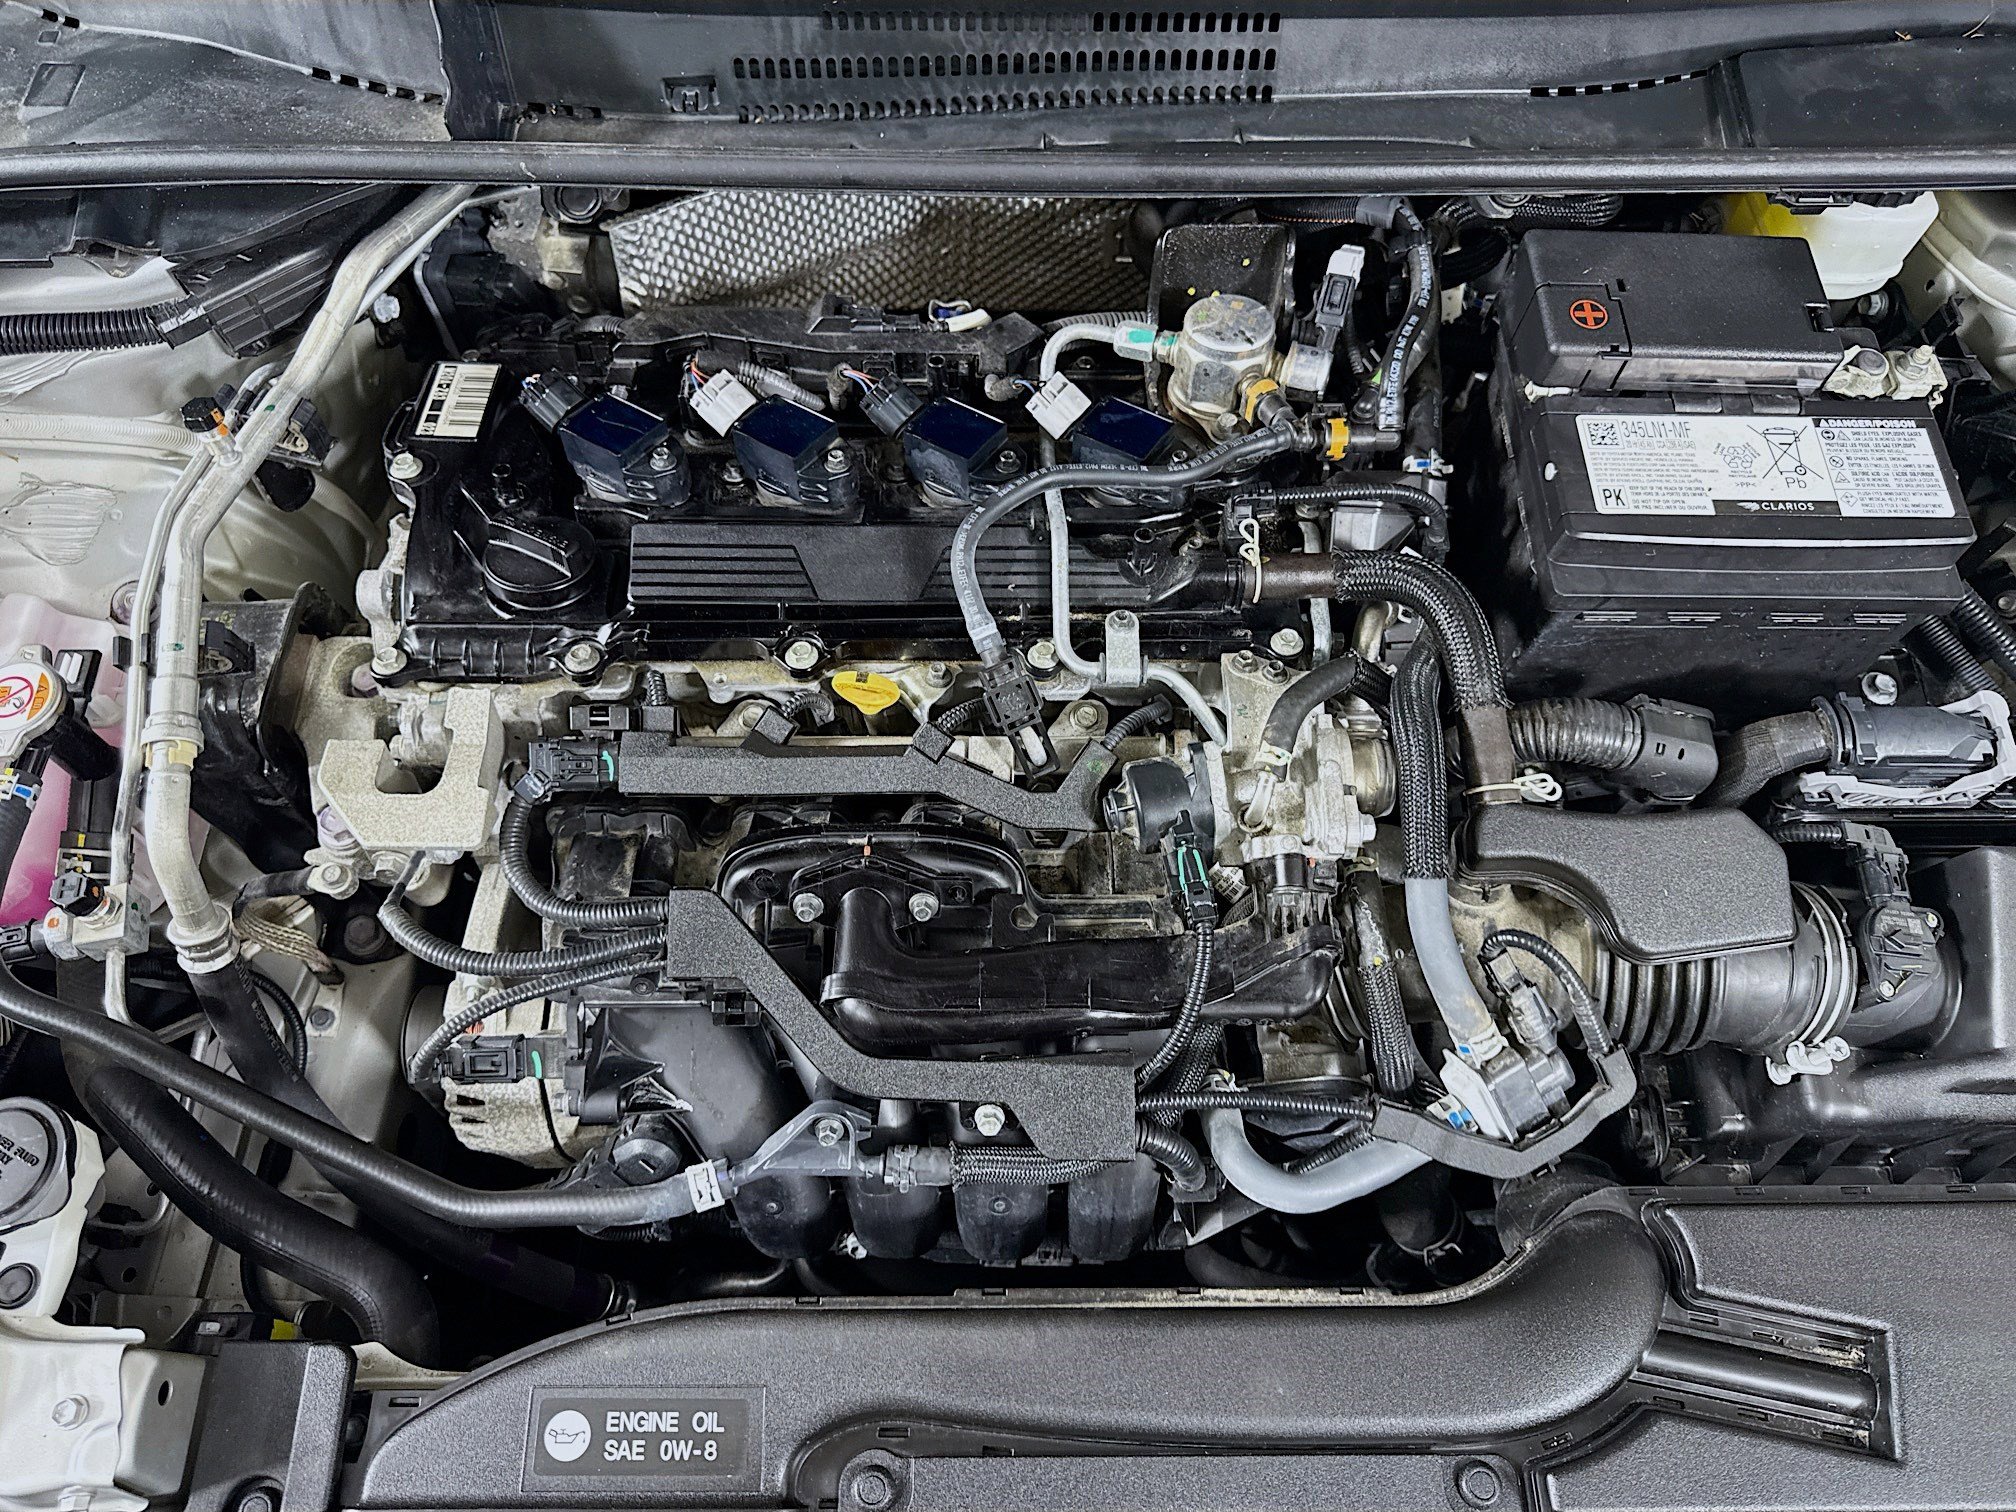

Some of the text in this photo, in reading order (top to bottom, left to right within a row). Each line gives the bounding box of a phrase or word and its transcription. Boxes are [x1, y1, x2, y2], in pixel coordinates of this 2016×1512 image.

[1622, 421, 1690, 438] 345LN1-MF
[1829, 419, 1916, 428] DANGER/POISON
[1785, 477, 1806, 488] Pb
[1602, 488, 1625, 506] PK
[1762, 502, 1814, 511] CLARIOS
[605, 1411, 724, 1432] ENGINE OIL
[603, 1440, 718, 1461] SAE 0W-8
